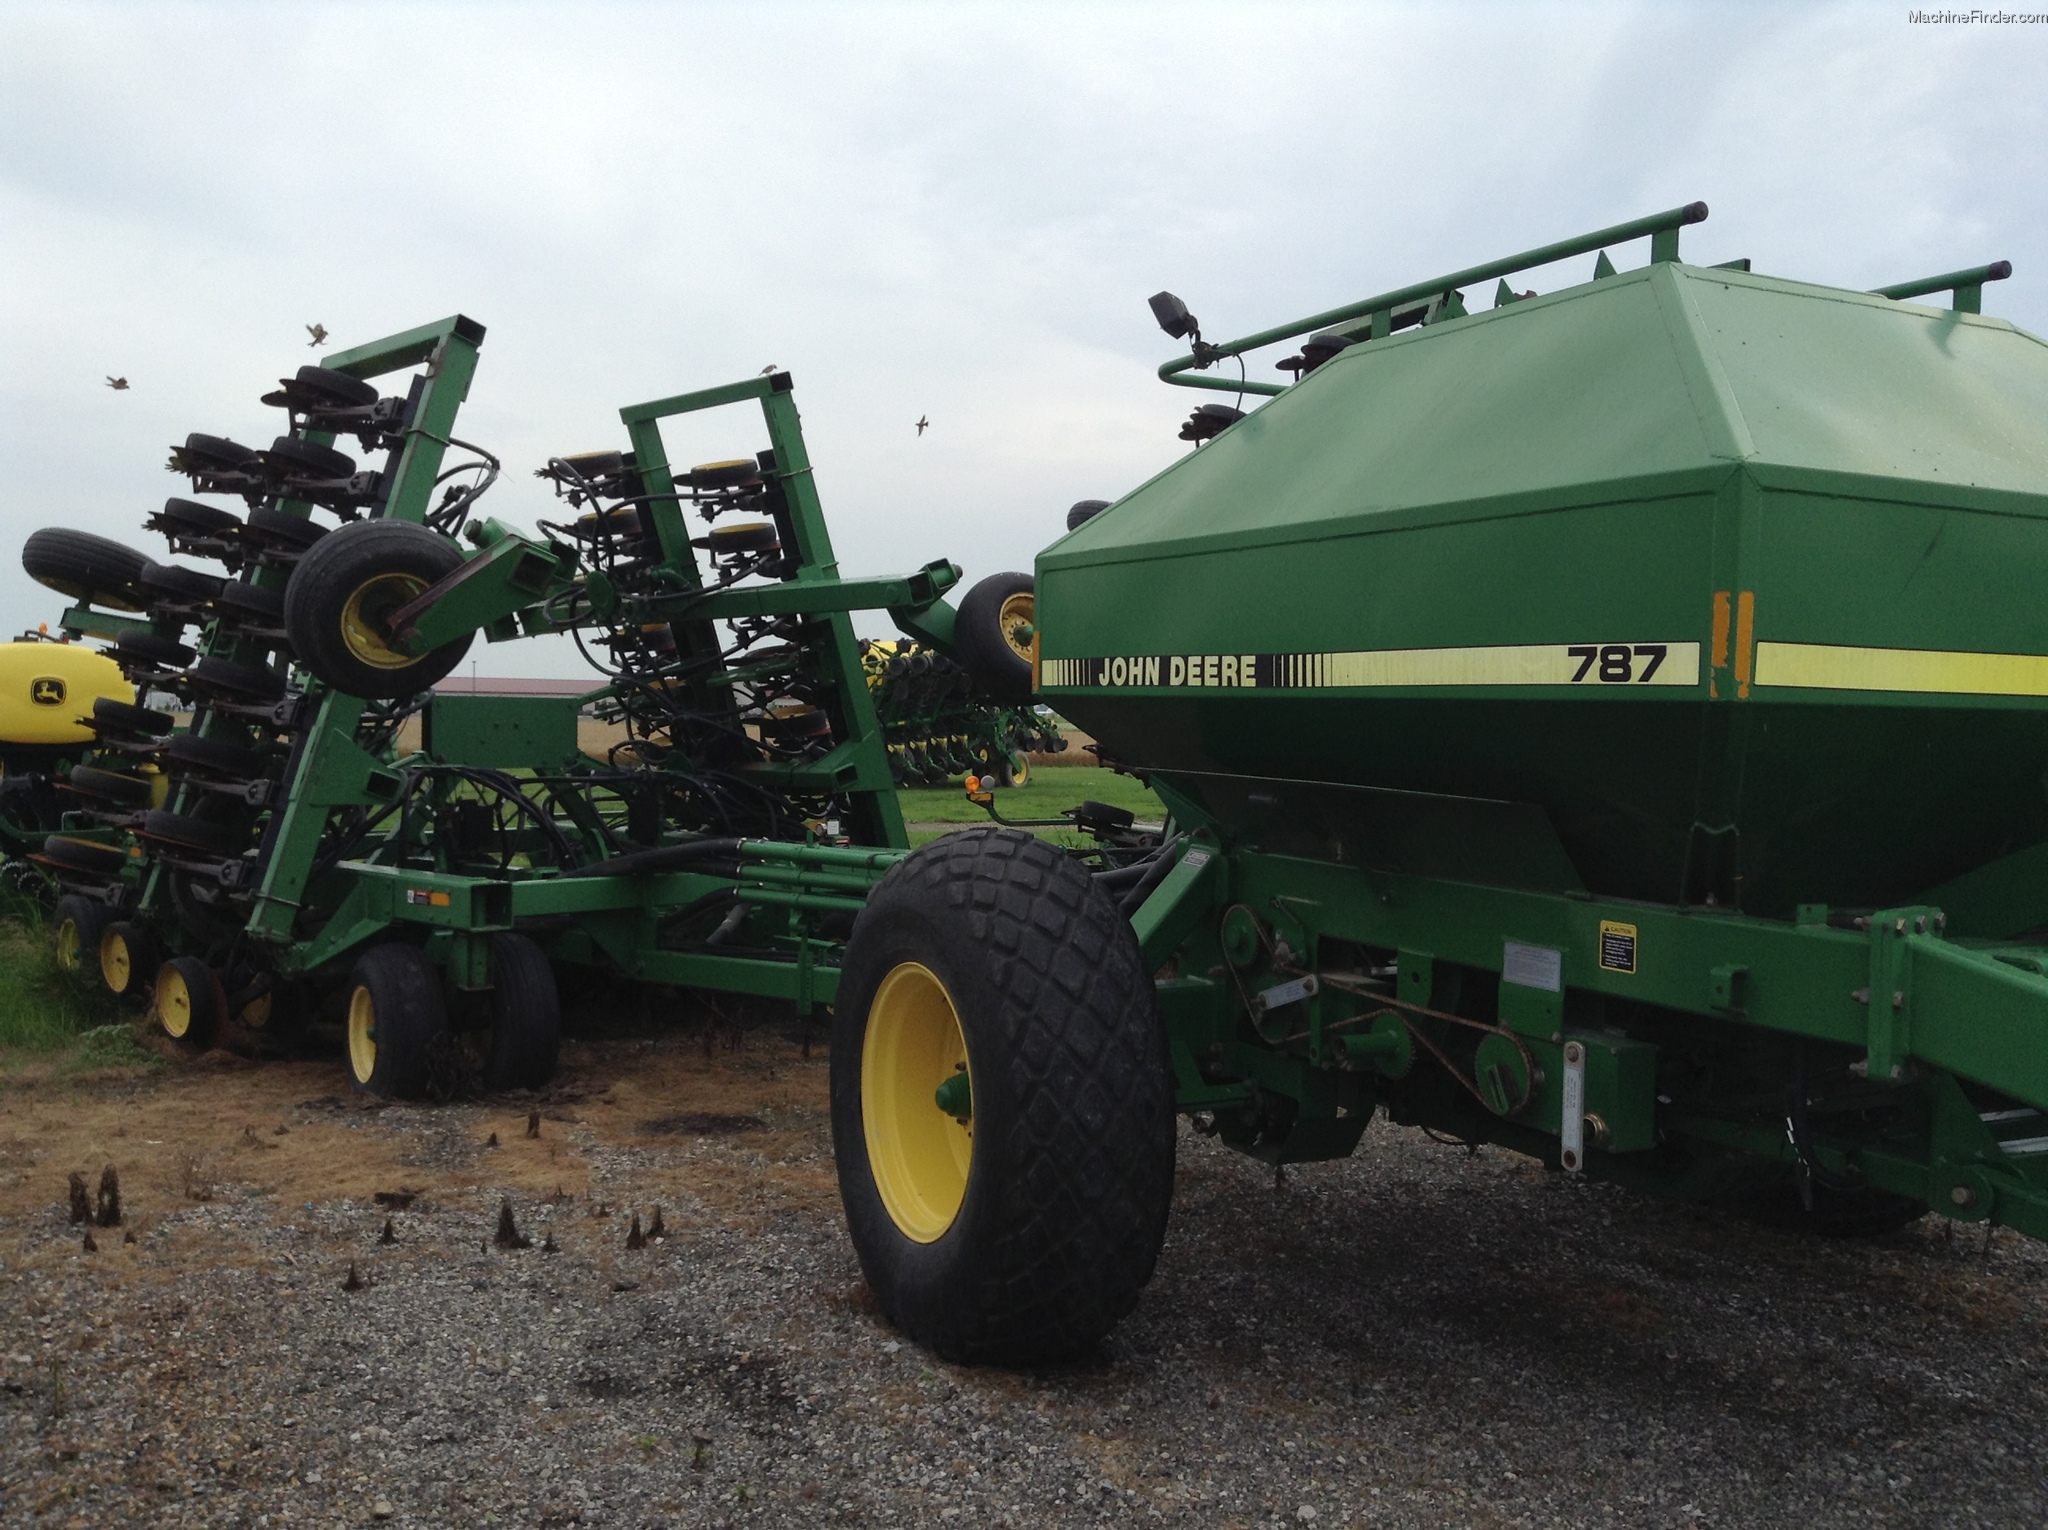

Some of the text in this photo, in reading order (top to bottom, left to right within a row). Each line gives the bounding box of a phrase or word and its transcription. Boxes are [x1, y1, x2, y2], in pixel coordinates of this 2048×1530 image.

[1098, 655, 1257, 688] JOHN DEERE
[1567, 645, 1668, 683] 787
